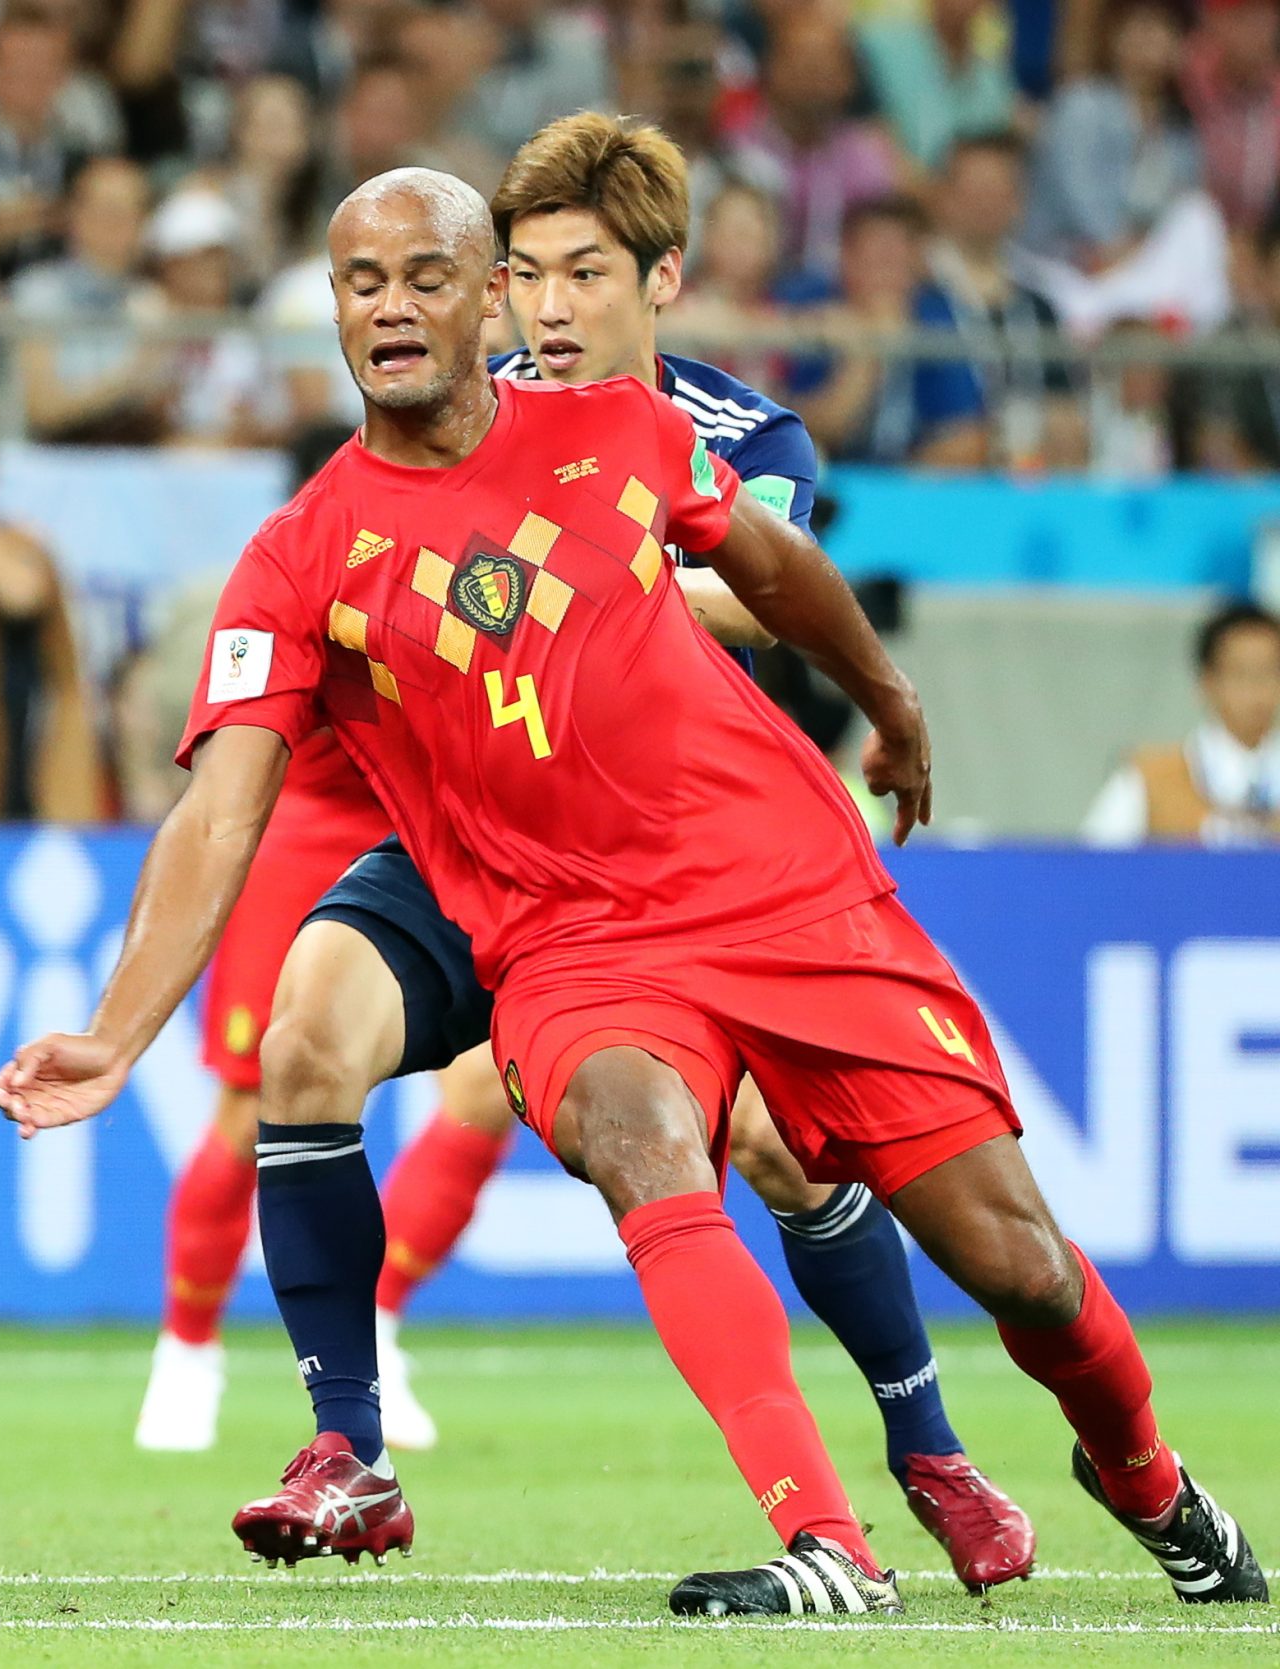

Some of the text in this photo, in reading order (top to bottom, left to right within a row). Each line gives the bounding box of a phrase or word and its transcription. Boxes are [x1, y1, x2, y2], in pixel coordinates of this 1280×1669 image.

[345, 537, 396, 570] adidas
[483, 669, 553, 760] 4
[916, 1006, 977, 1067] 4
